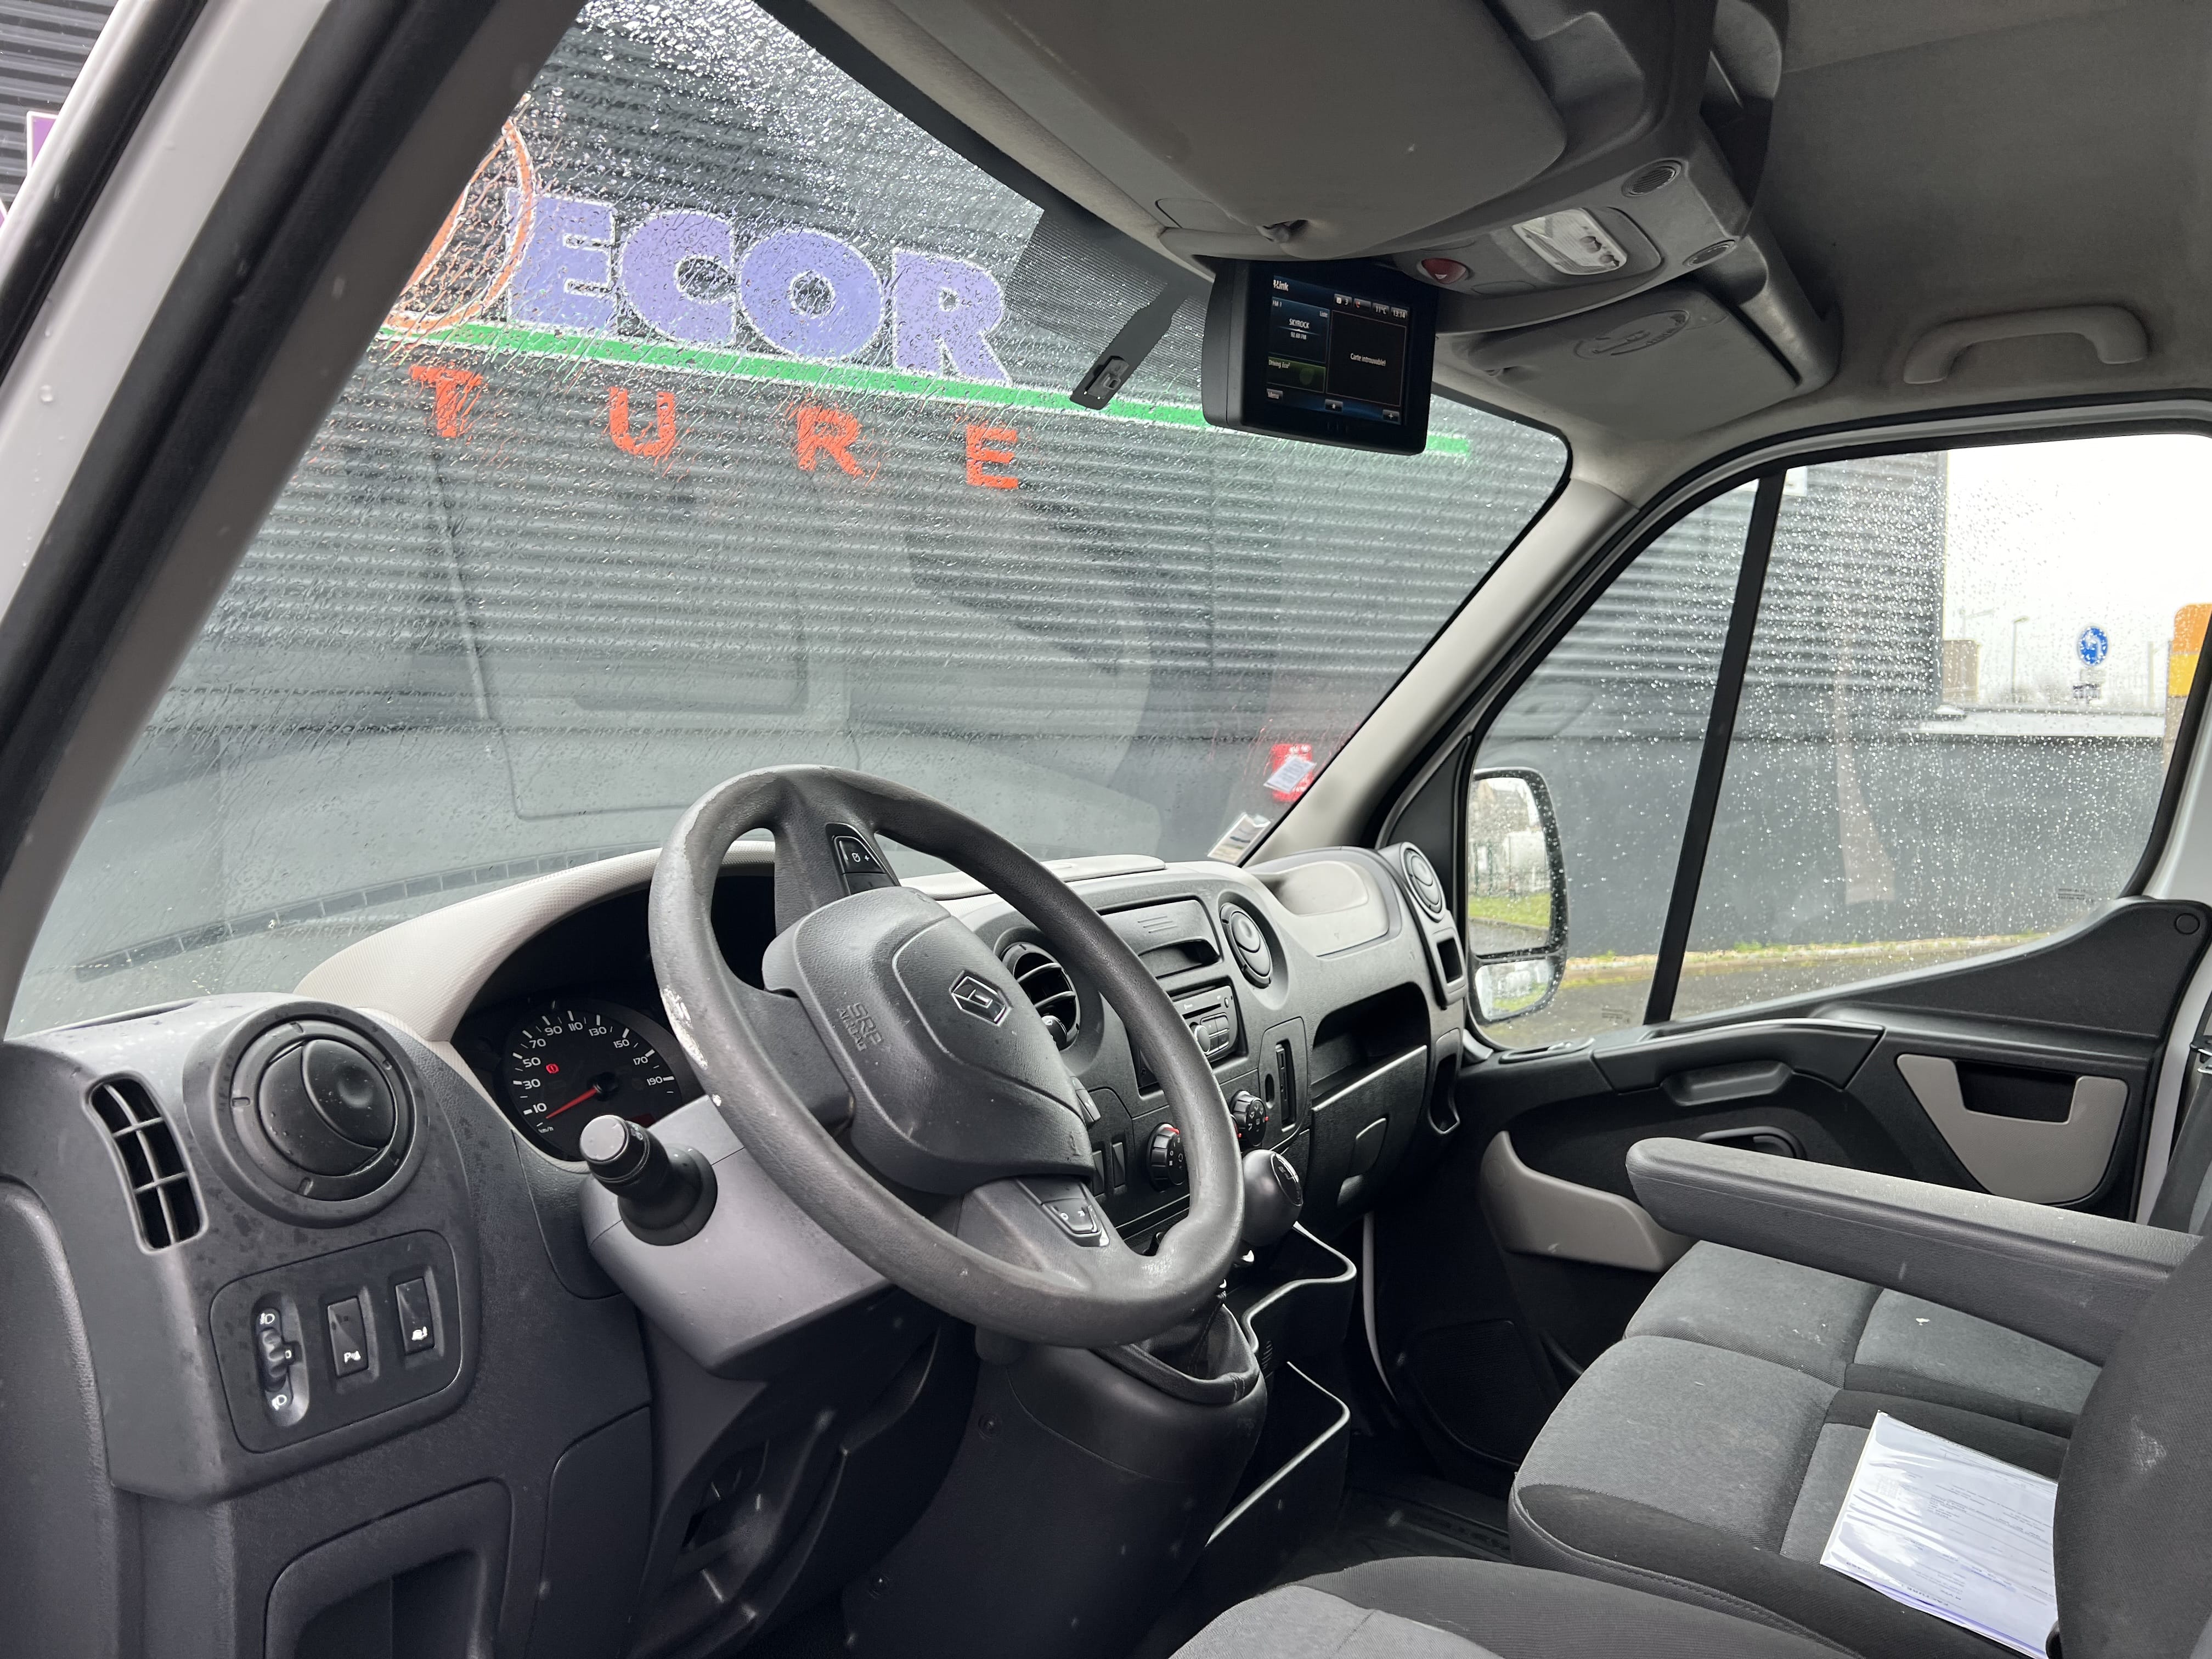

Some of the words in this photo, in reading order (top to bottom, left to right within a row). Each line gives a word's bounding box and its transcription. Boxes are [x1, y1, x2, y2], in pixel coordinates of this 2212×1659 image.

[1289, 318, 1310, 329] SKYROCK
[544, 1026, 562, 1036] 90
[568, 1022, 583, 1031] 110
[589, 1026, 607, 1036] 130
[529, 1039, 546, 1048] 70
[613, 1039, 630, 1048] 150
[522, 1057, 541, 1068] 50
[633, 1056, 648, 1065] 170
[522, 1079, 541, 1090] 30
[646, 1076, 663, 1086] 190
[533, 1103, 547, 1113] 10
